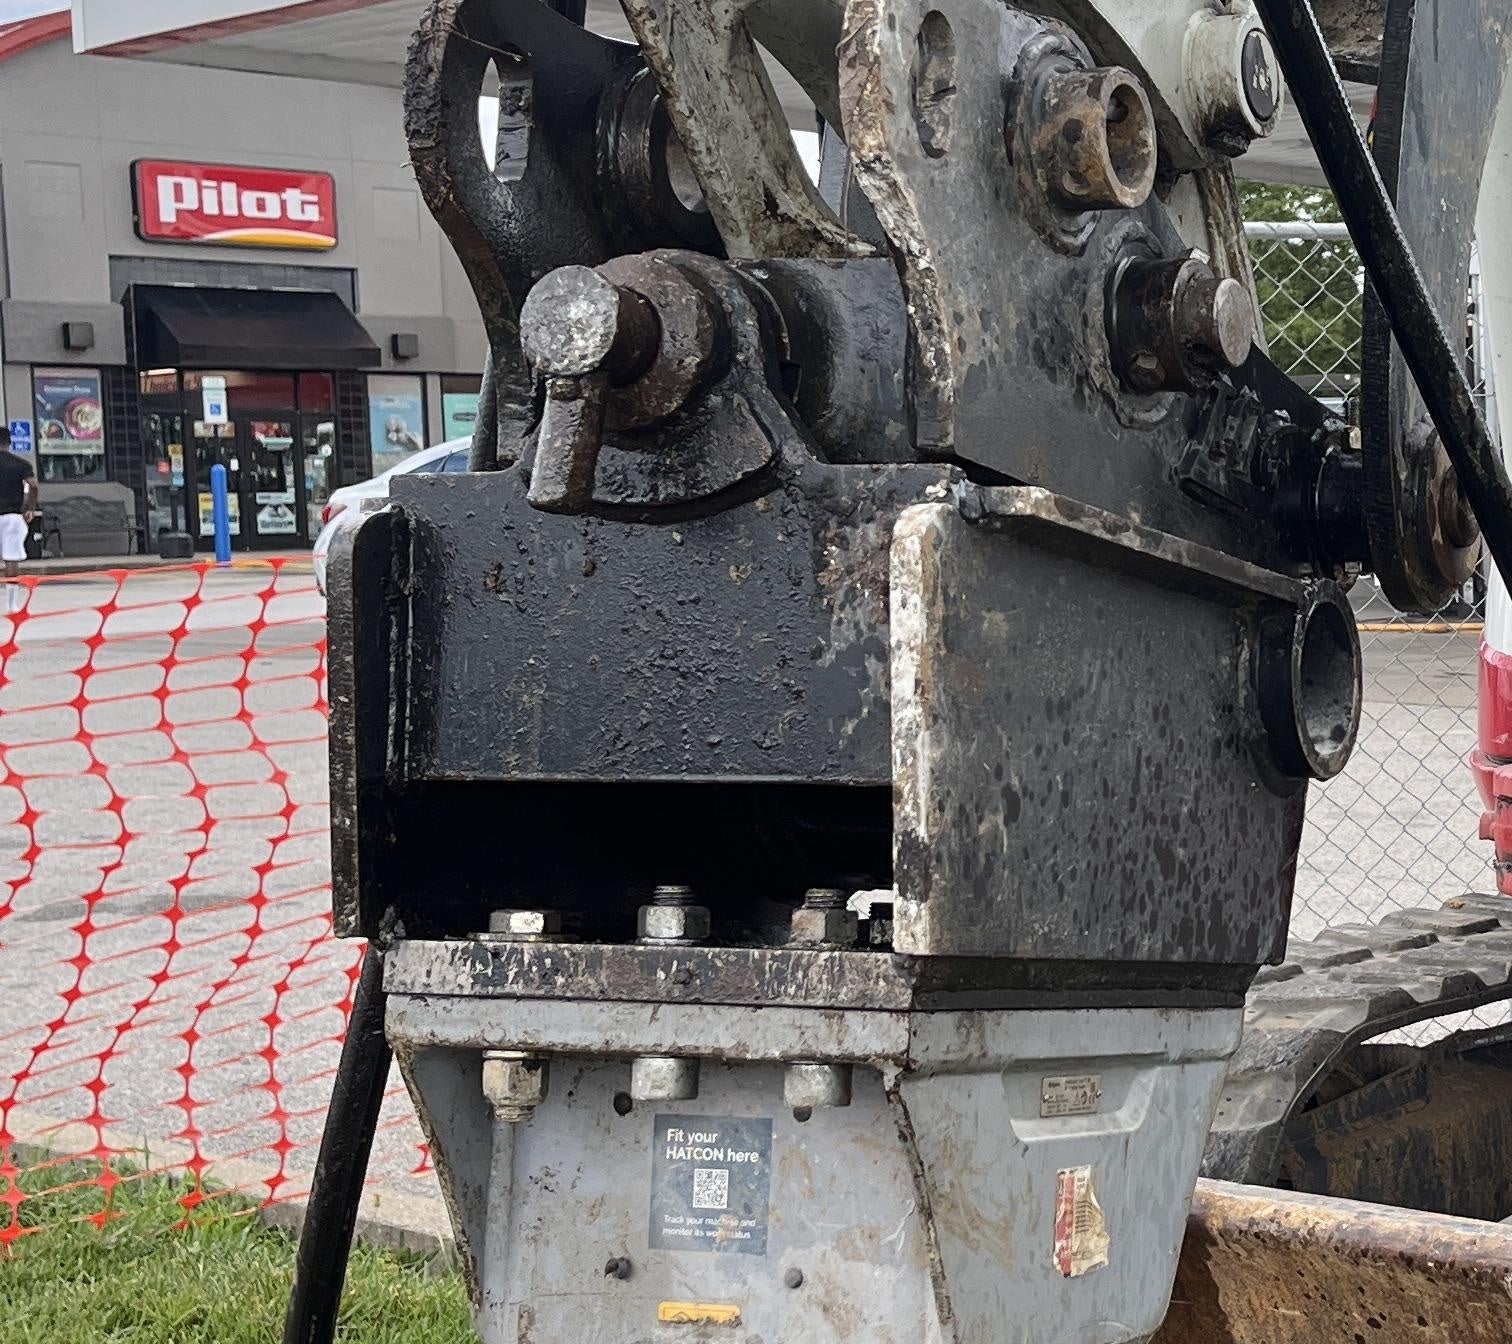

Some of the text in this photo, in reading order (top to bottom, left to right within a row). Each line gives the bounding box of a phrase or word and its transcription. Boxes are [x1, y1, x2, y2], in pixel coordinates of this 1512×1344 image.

[156, 174, 320, 223] Pilot
[666, 1128, 719, 1146] Fit your
[665, 1146, 760, 1163] HATCON here
[664, 1214, 684, 1224] Track
[686, 1217, 703, 1226] your
[740, 1219, 756, 1227] and
[662, 1227, 693, 1236] monitor
